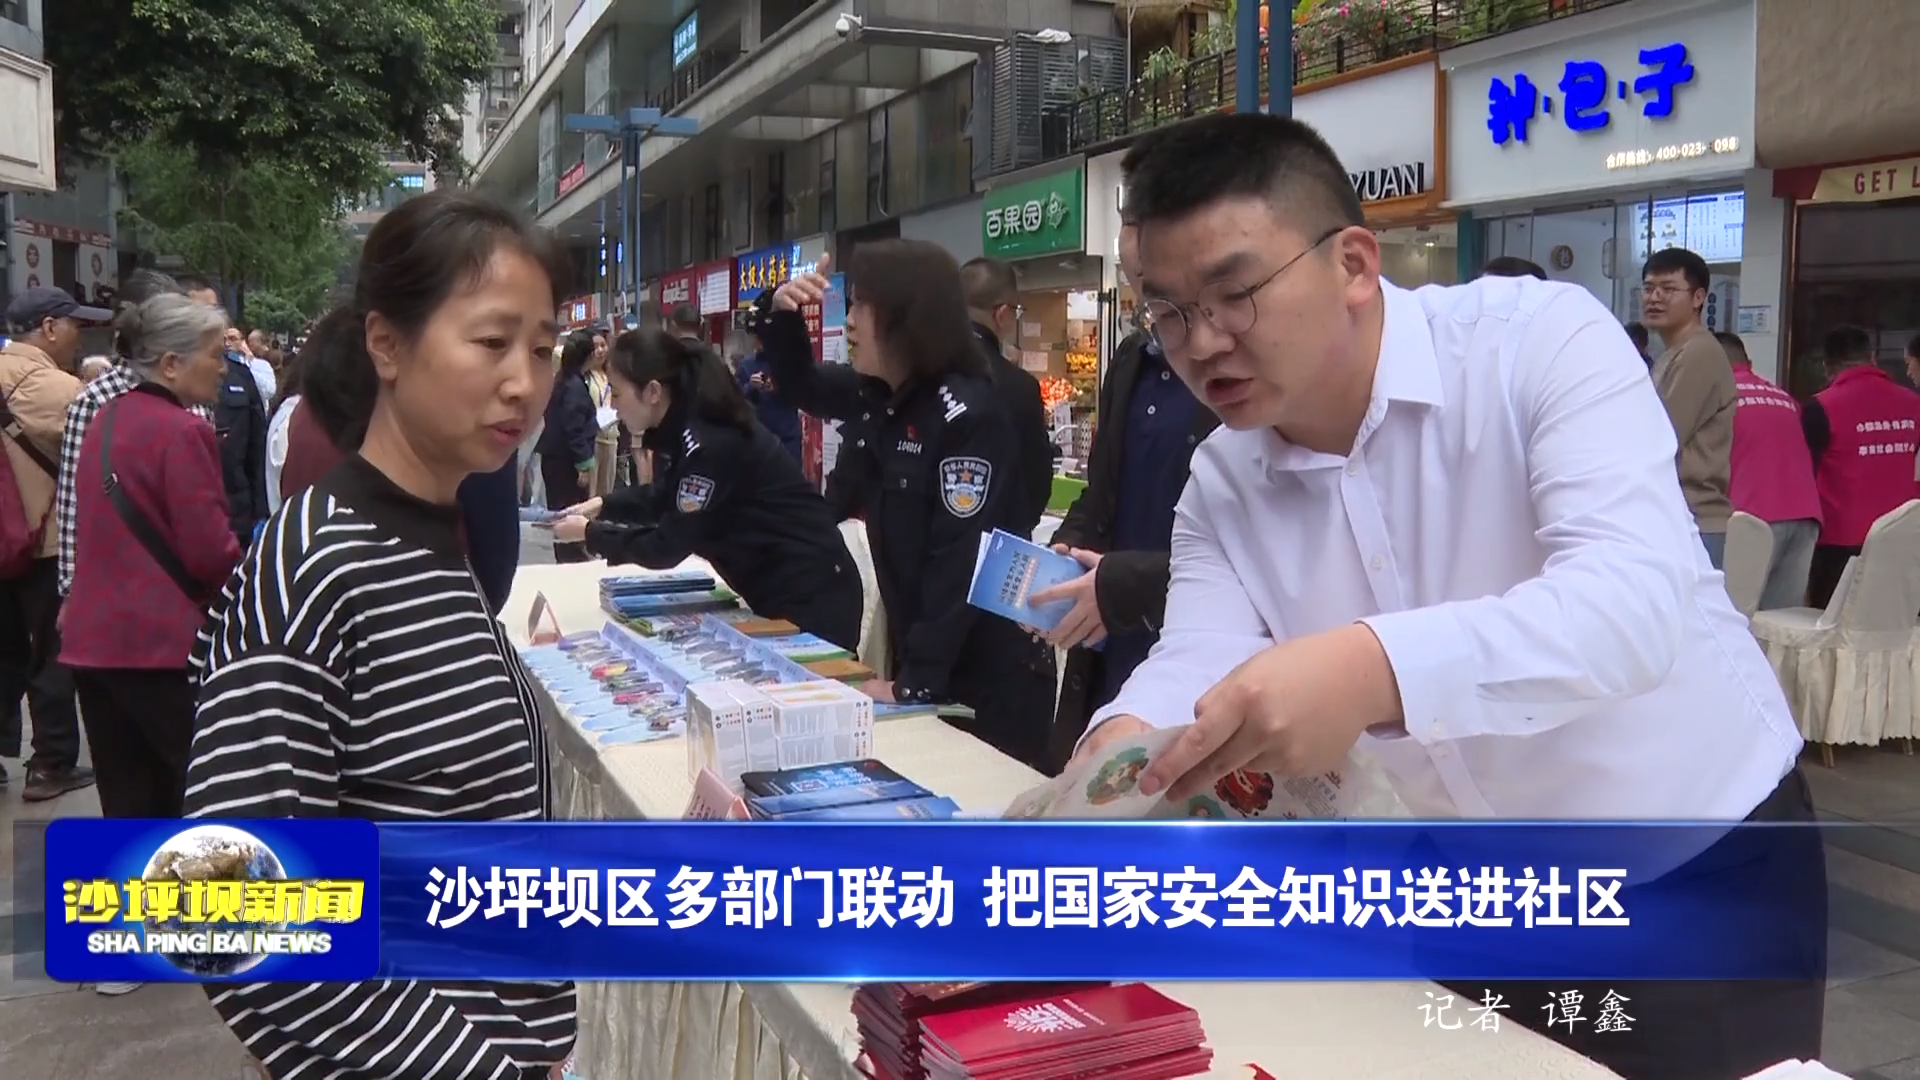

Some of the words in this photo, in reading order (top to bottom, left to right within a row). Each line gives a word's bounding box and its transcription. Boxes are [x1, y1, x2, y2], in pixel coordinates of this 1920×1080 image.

[1854, 168, 1898, 195] GET
[986, 200, 1042, 238] 百果园
